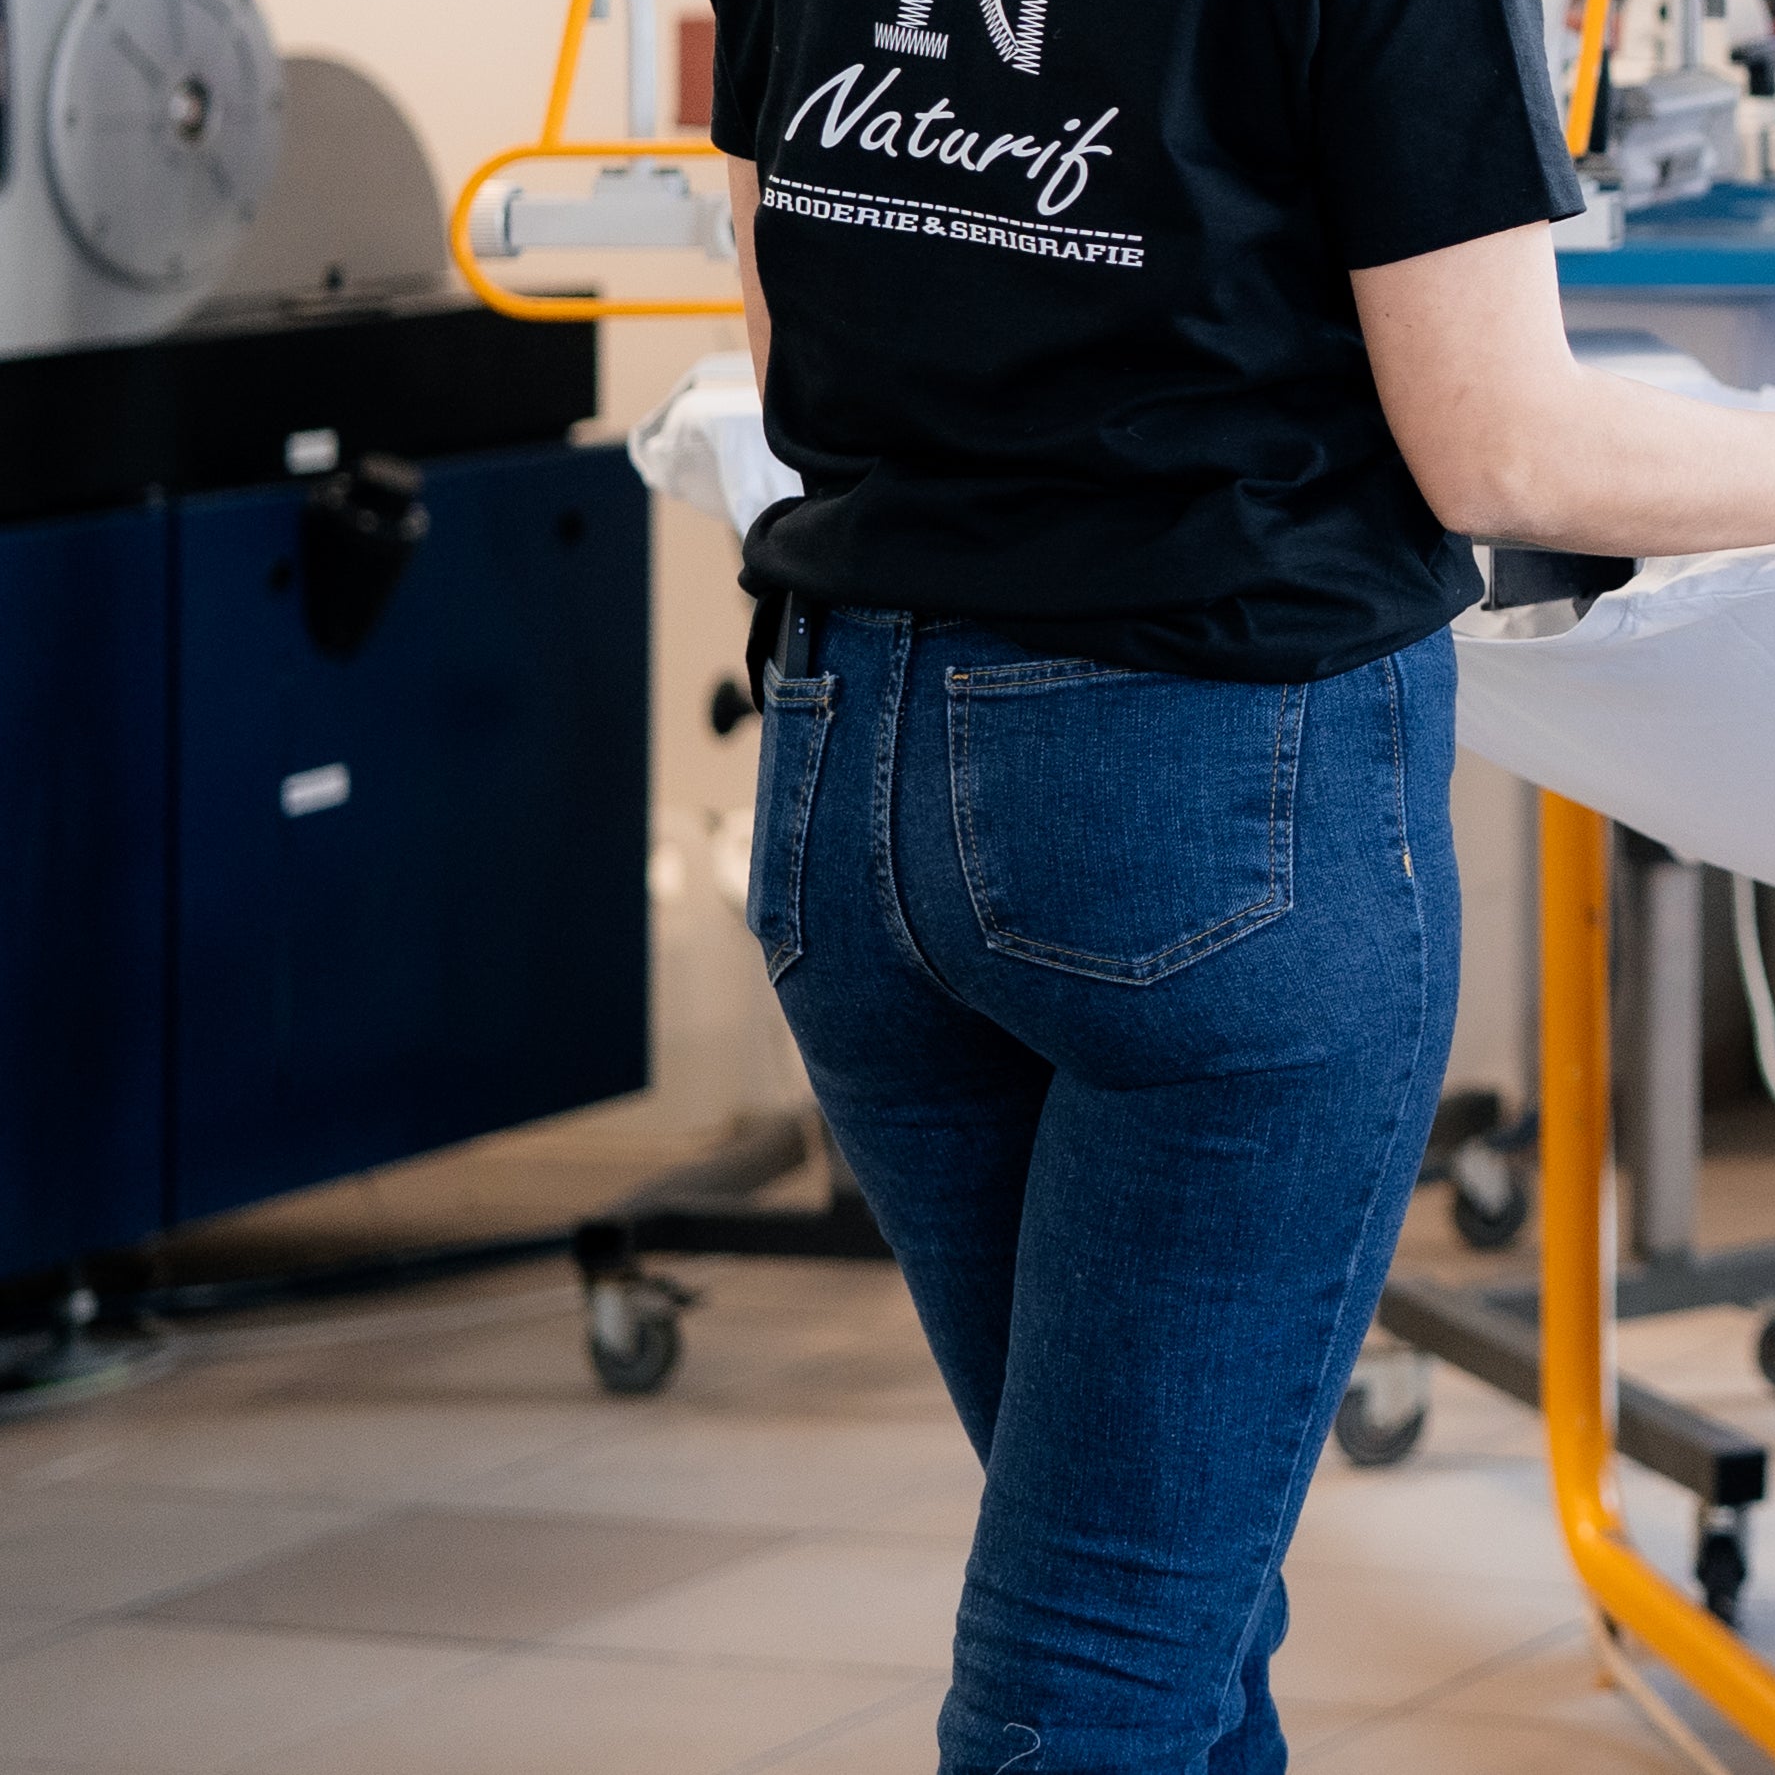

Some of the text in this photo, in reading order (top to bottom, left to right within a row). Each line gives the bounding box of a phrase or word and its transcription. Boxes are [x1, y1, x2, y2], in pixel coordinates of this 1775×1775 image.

[785, 64, 1119, 216] Naturif
[762, 186, 1145, 268] BRODERIE & SERIGRAFIE
